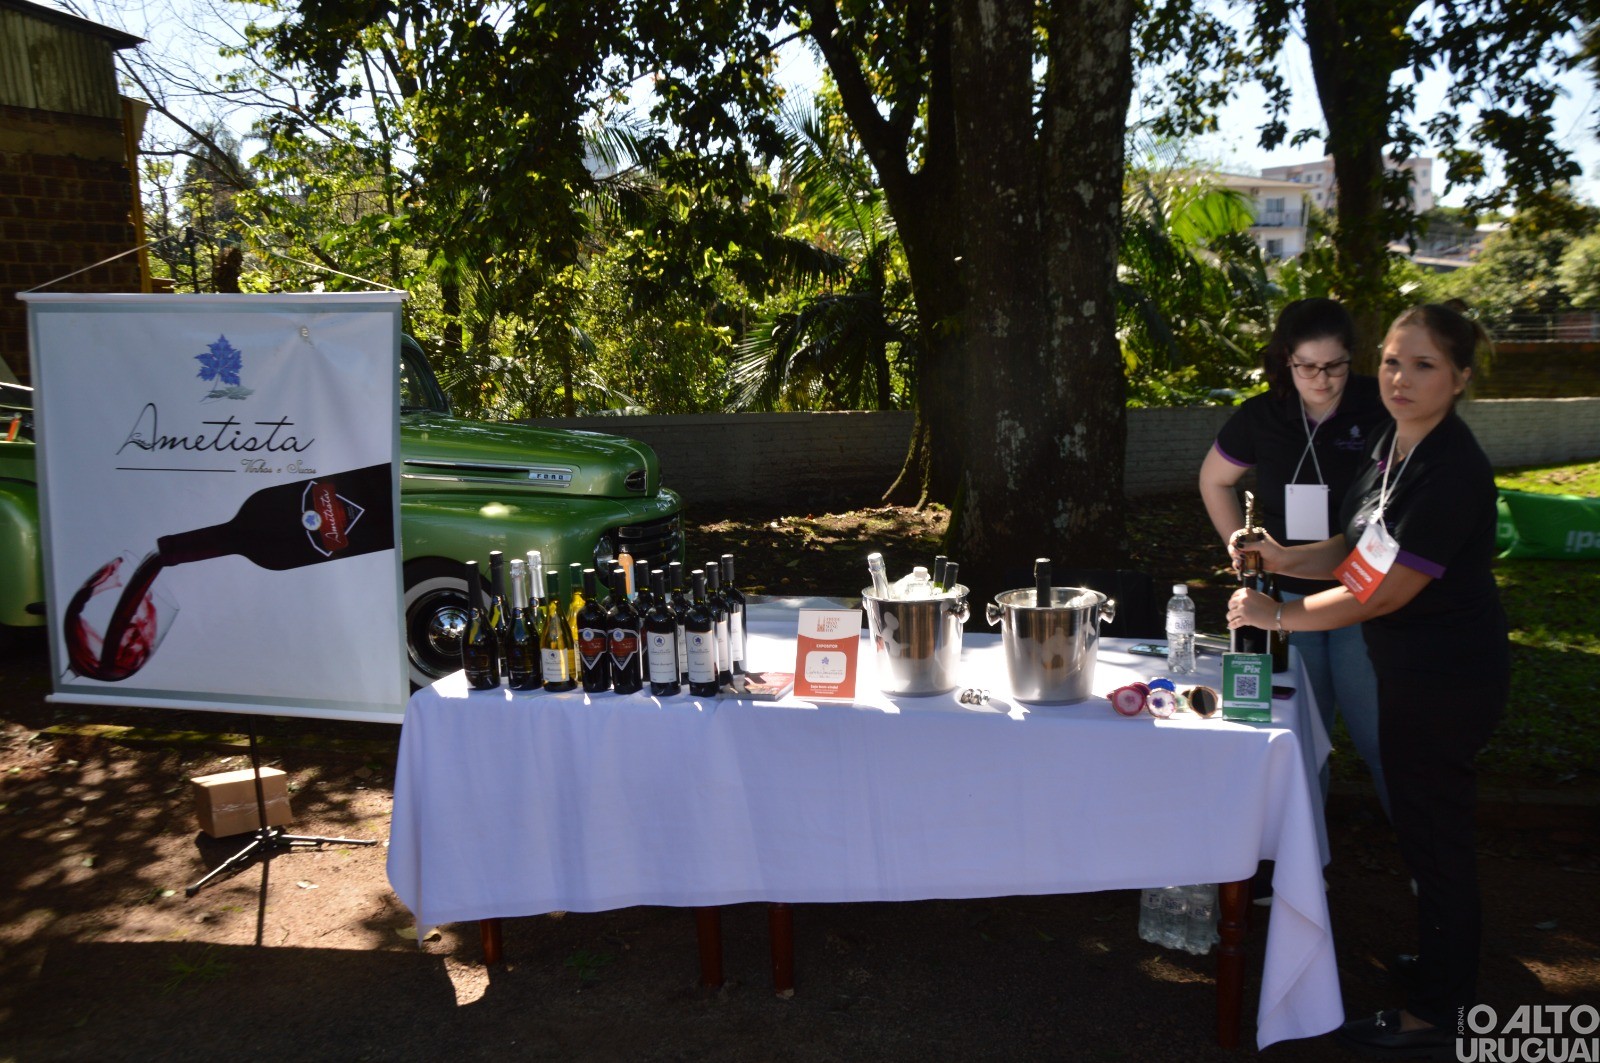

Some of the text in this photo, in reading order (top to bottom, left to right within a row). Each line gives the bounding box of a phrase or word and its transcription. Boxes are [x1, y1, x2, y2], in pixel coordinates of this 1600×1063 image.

[116, 402, 315, 455] Ametista
[240, 459, 273, 473] Vinhos
[287, 459, 317, 474] Sucos
[320, 488, 342, 544] Ametista
[1244, 664, 1261, 673] Pix
